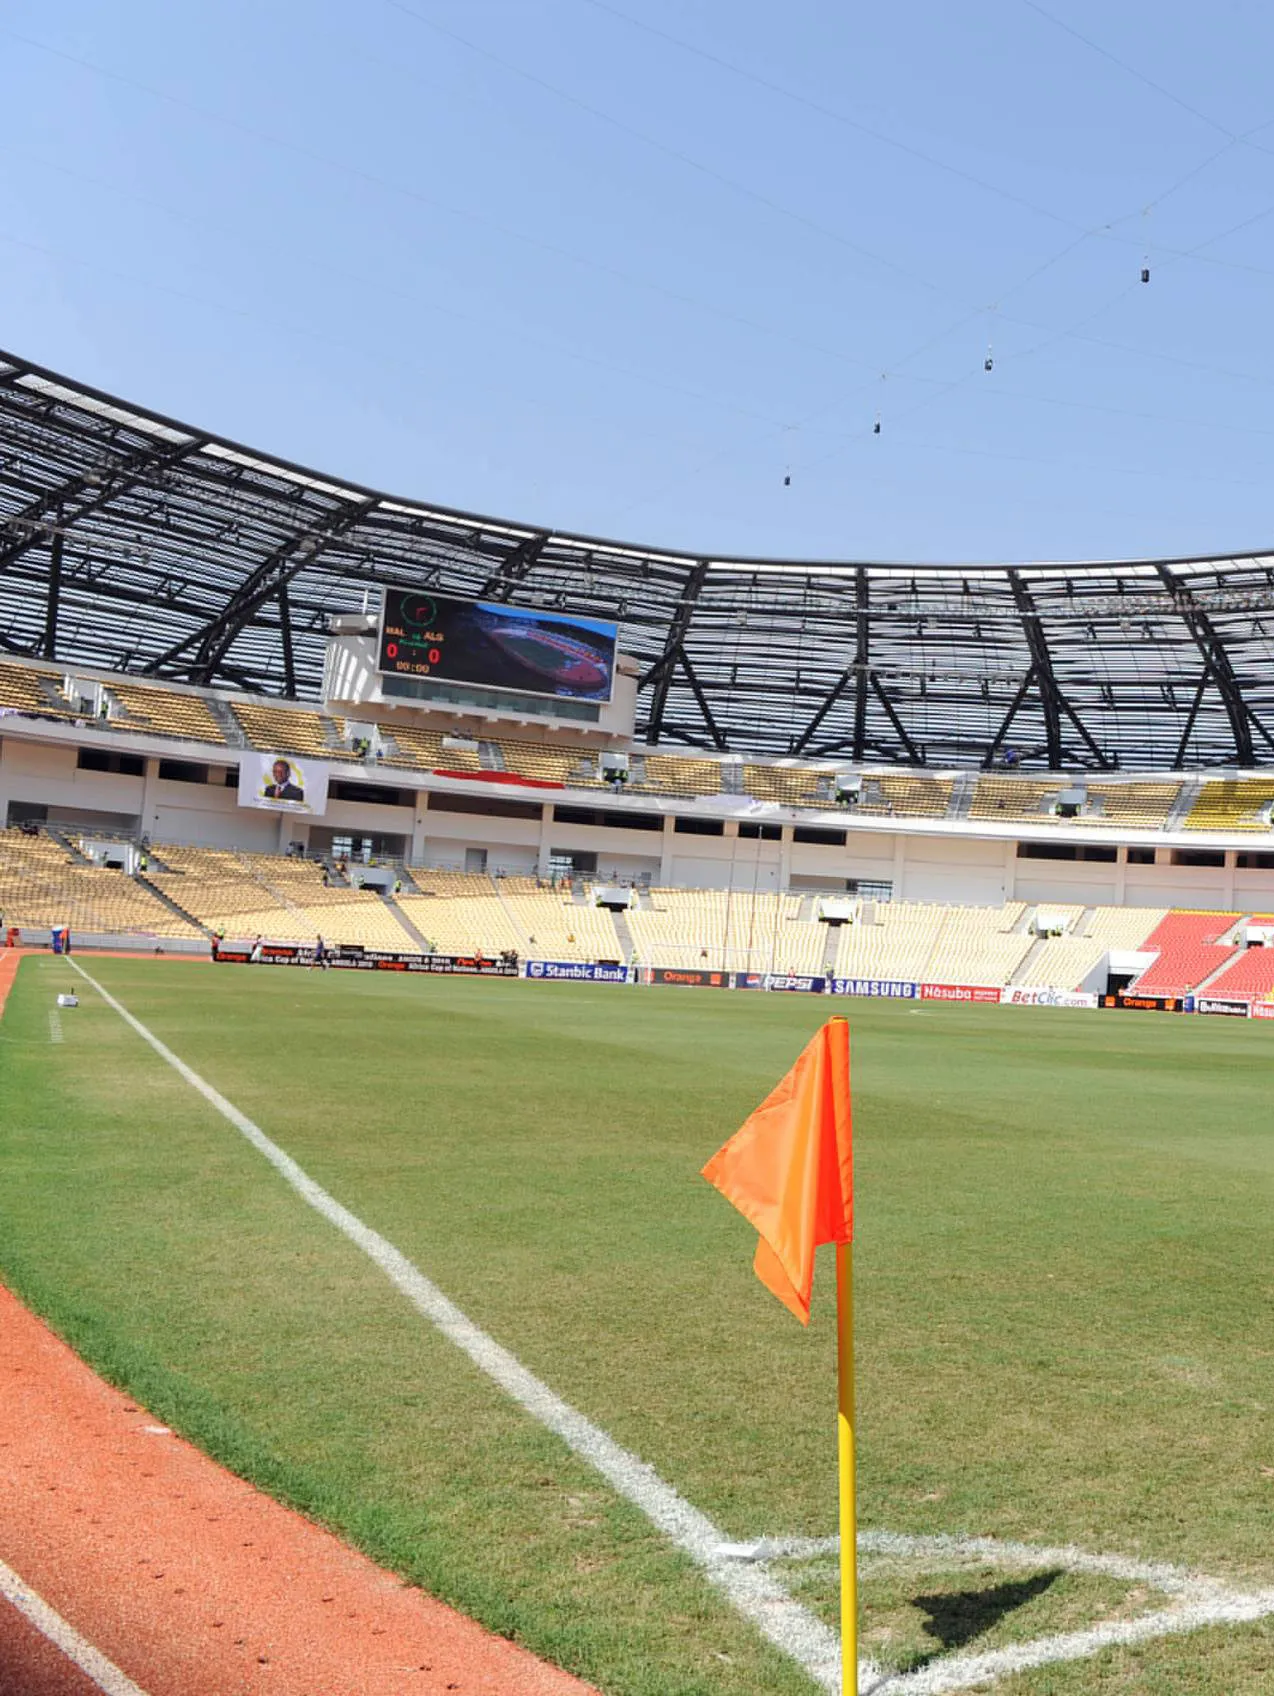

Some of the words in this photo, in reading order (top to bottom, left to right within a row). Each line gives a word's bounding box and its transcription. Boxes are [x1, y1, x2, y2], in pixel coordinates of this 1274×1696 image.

[387, 643, 398, 658] 0
[429, 648, 440, 664] 0
[545, 964, 590, 979] Stanbic
[593, 965, 624, 981] Bank
[663, 970, 702, 983] Orange
[834, 980, 912, 997] SAMSUNG
[1123, 997, 1157, 1008] Orange
